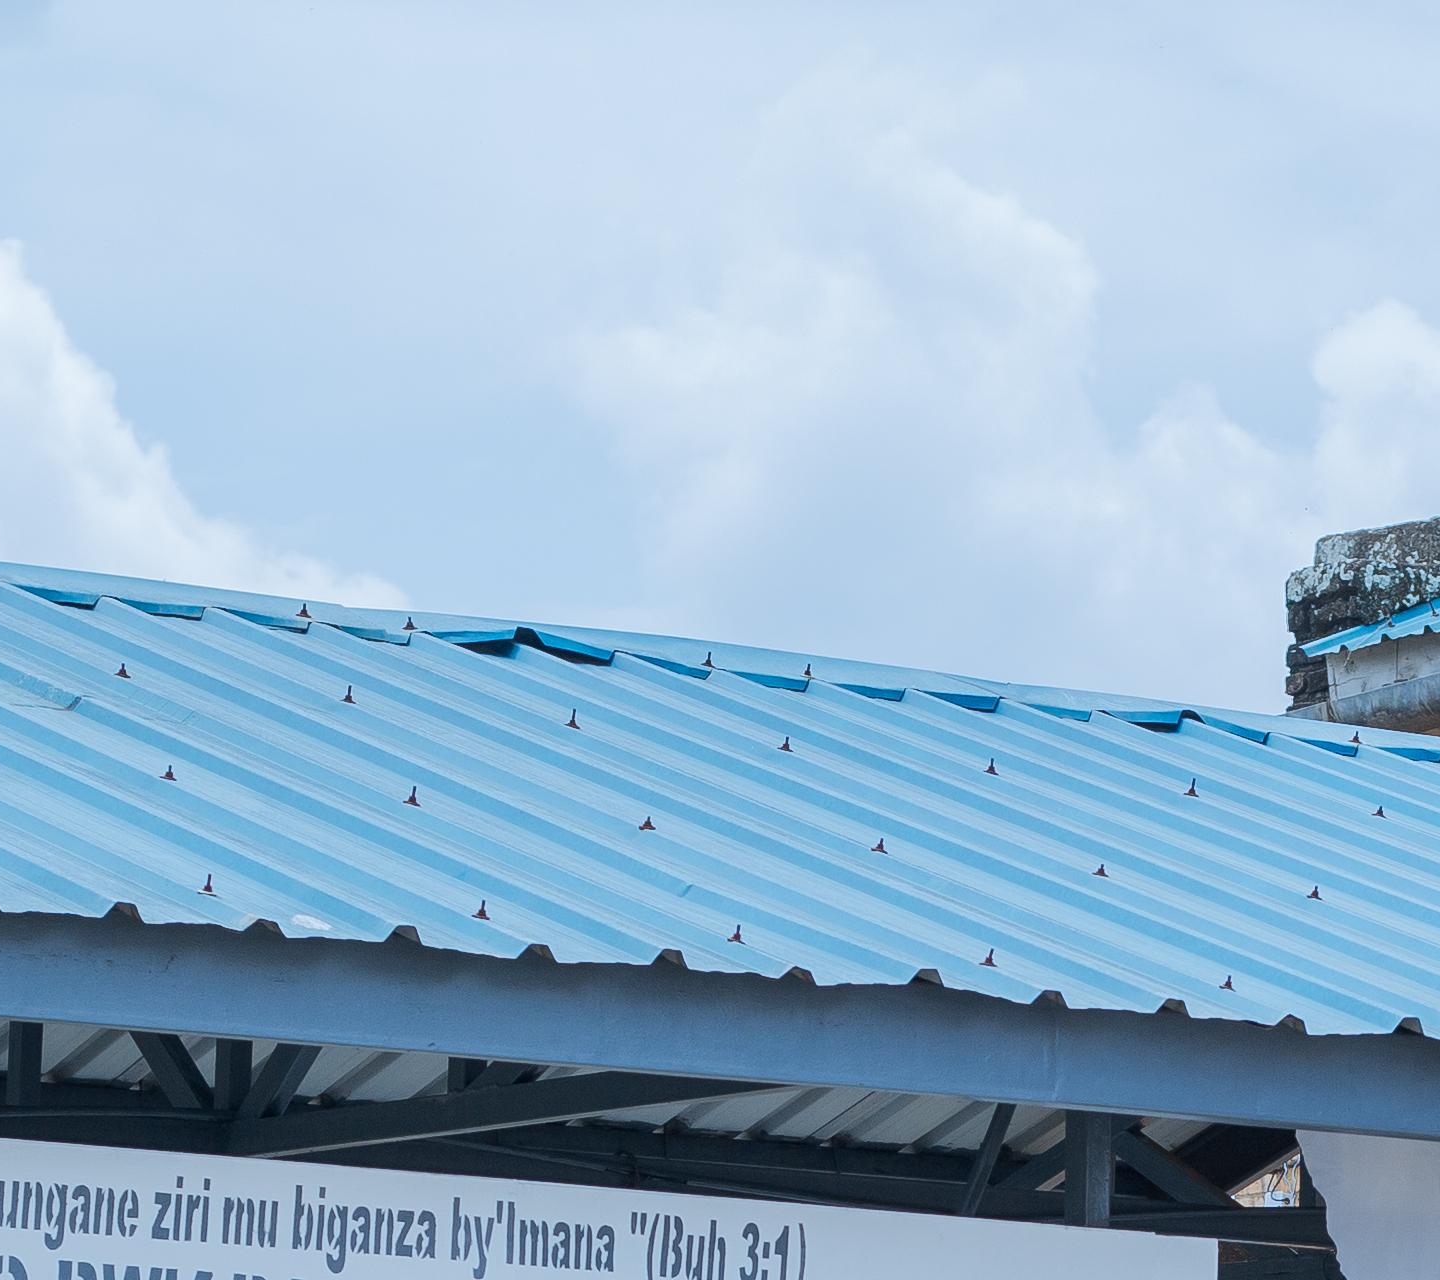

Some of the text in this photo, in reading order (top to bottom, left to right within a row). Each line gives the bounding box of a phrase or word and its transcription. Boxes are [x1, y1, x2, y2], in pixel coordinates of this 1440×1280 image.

[152, 1176, 211, 1242] ziri
[222, 1197, 278, 1248] mu
[292, 1185, 436, 1274] biganza
[451, 1197, 615, 1279] by'Imana
